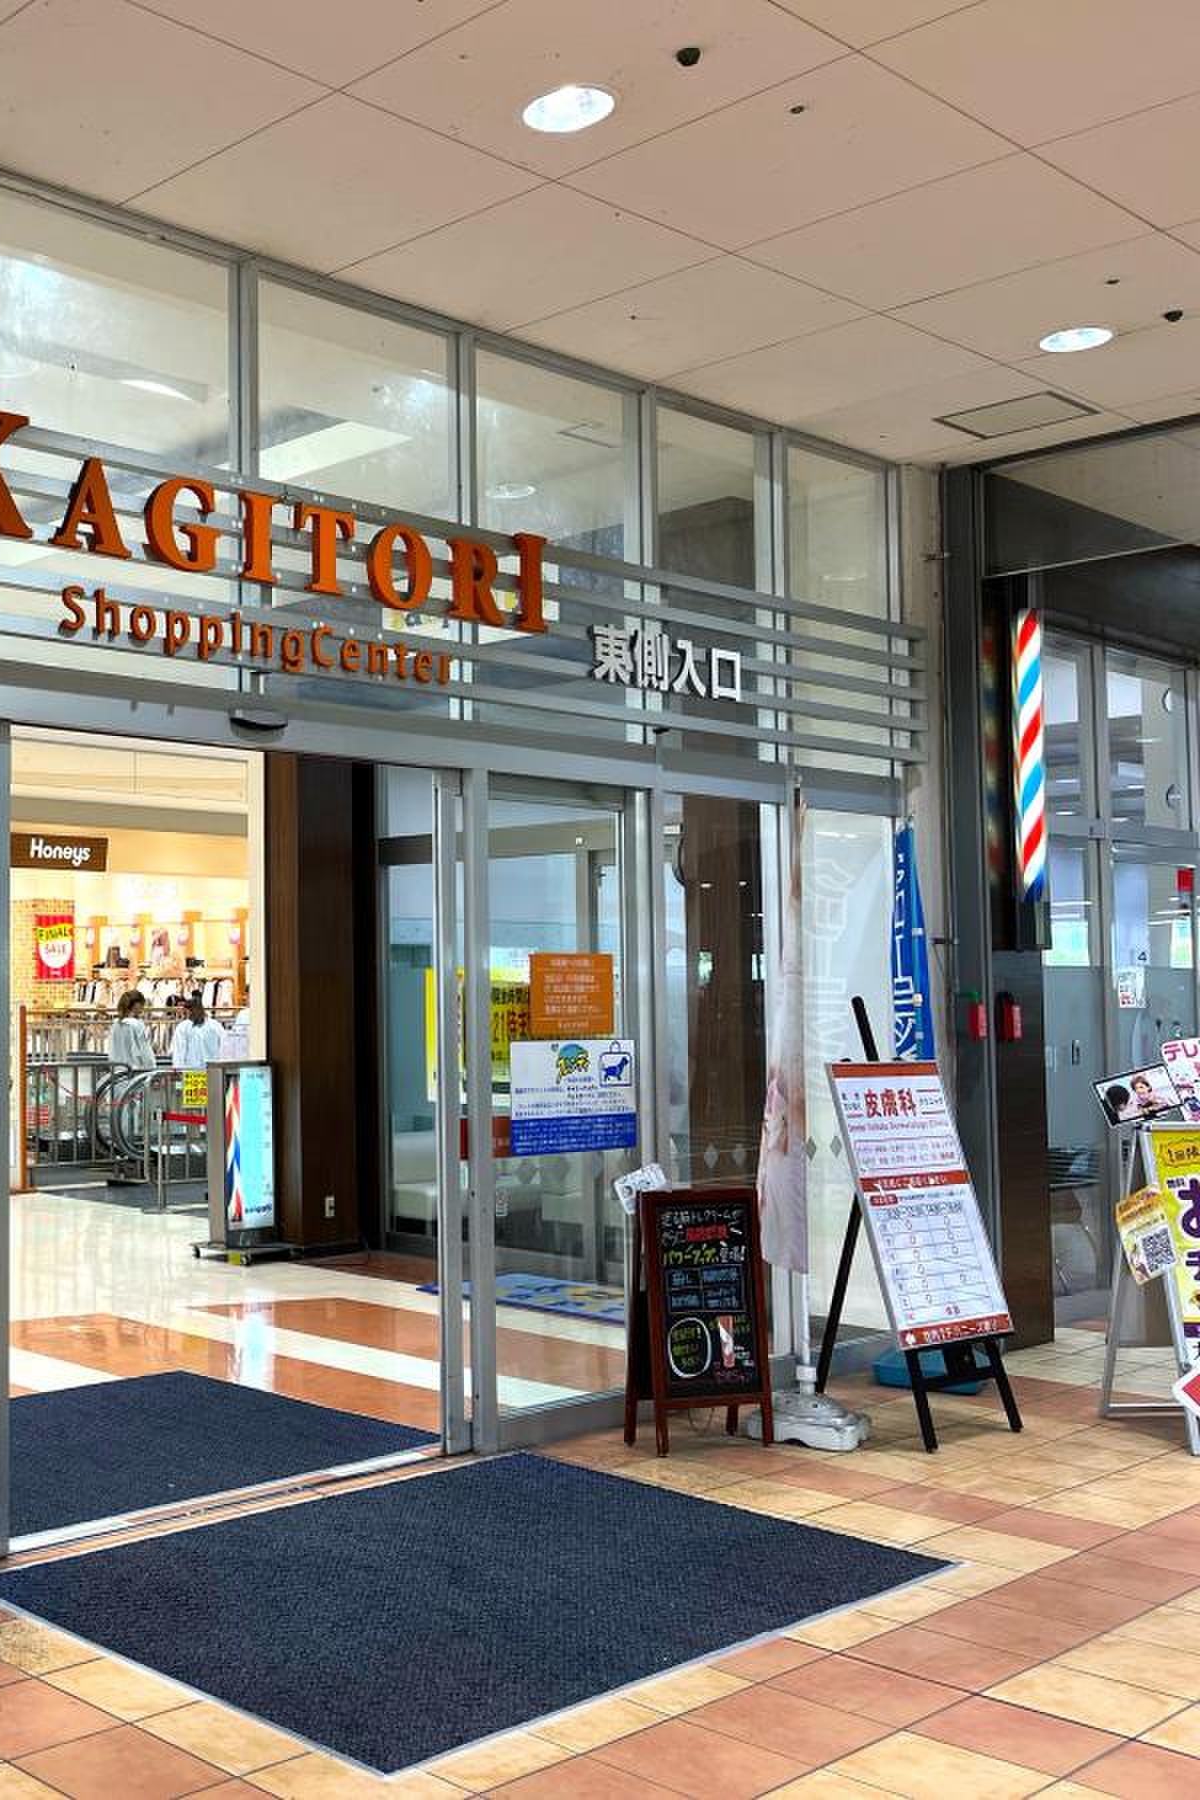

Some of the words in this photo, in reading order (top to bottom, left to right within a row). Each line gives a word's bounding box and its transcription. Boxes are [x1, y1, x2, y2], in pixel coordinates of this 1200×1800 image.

[590, 622, 743, 703] 東側入口
[30, 838, 91, 866] Honeys
[864, 1088, 917, 1118] 皮膚科
